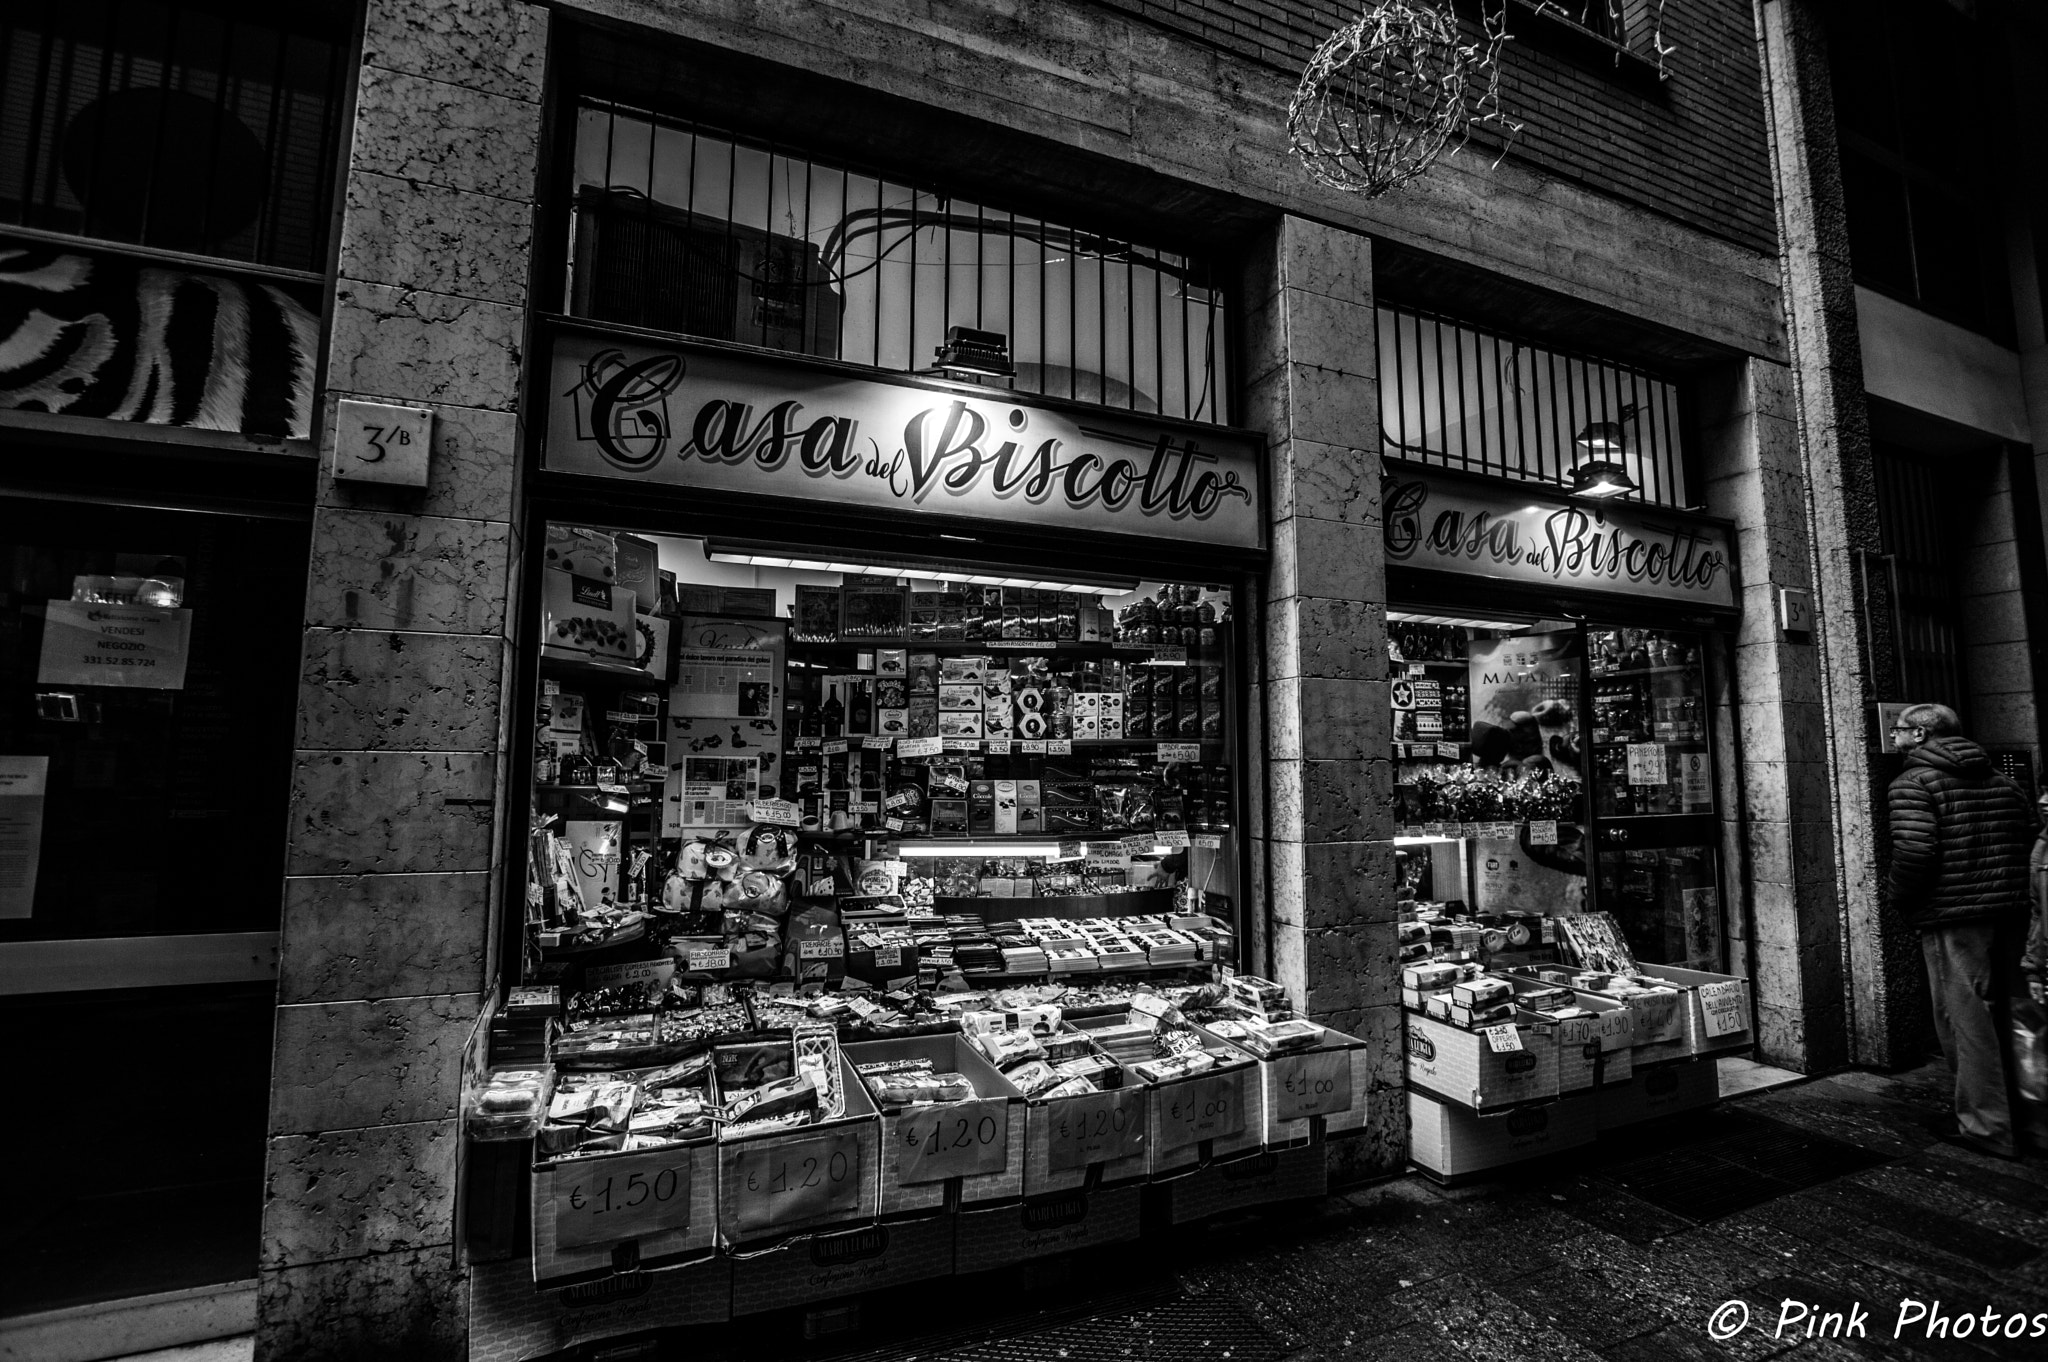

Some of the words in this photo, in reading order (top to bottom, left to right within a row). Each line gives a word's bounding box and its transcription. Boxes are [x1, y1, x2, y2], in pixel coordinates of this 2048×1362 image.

[585, 348, 863, 480] Casa
[865, 437, 908, 498] del
[904, 400, 1251, 519] Biscotto
[1382, 479, 1523, 566] Casa
[1527, 537, 1550, 573] del
[1545, 506, 1728, 587] Biscotto
[101, 626, 145, 636] VENDESI
[97, 641, 146, 652] NEGOZIO
[83, 655, 156, 667] 331.52.85.724
[905, 1115, 997, 1156] €1.20
[569, 1167, 678, 1215] €1.50
[817, 1239, 851, 1259] MARIA
[850, 1234, 882, 1253] LUIGIA
[608, 1273, 643, 1297] LUIGIA
